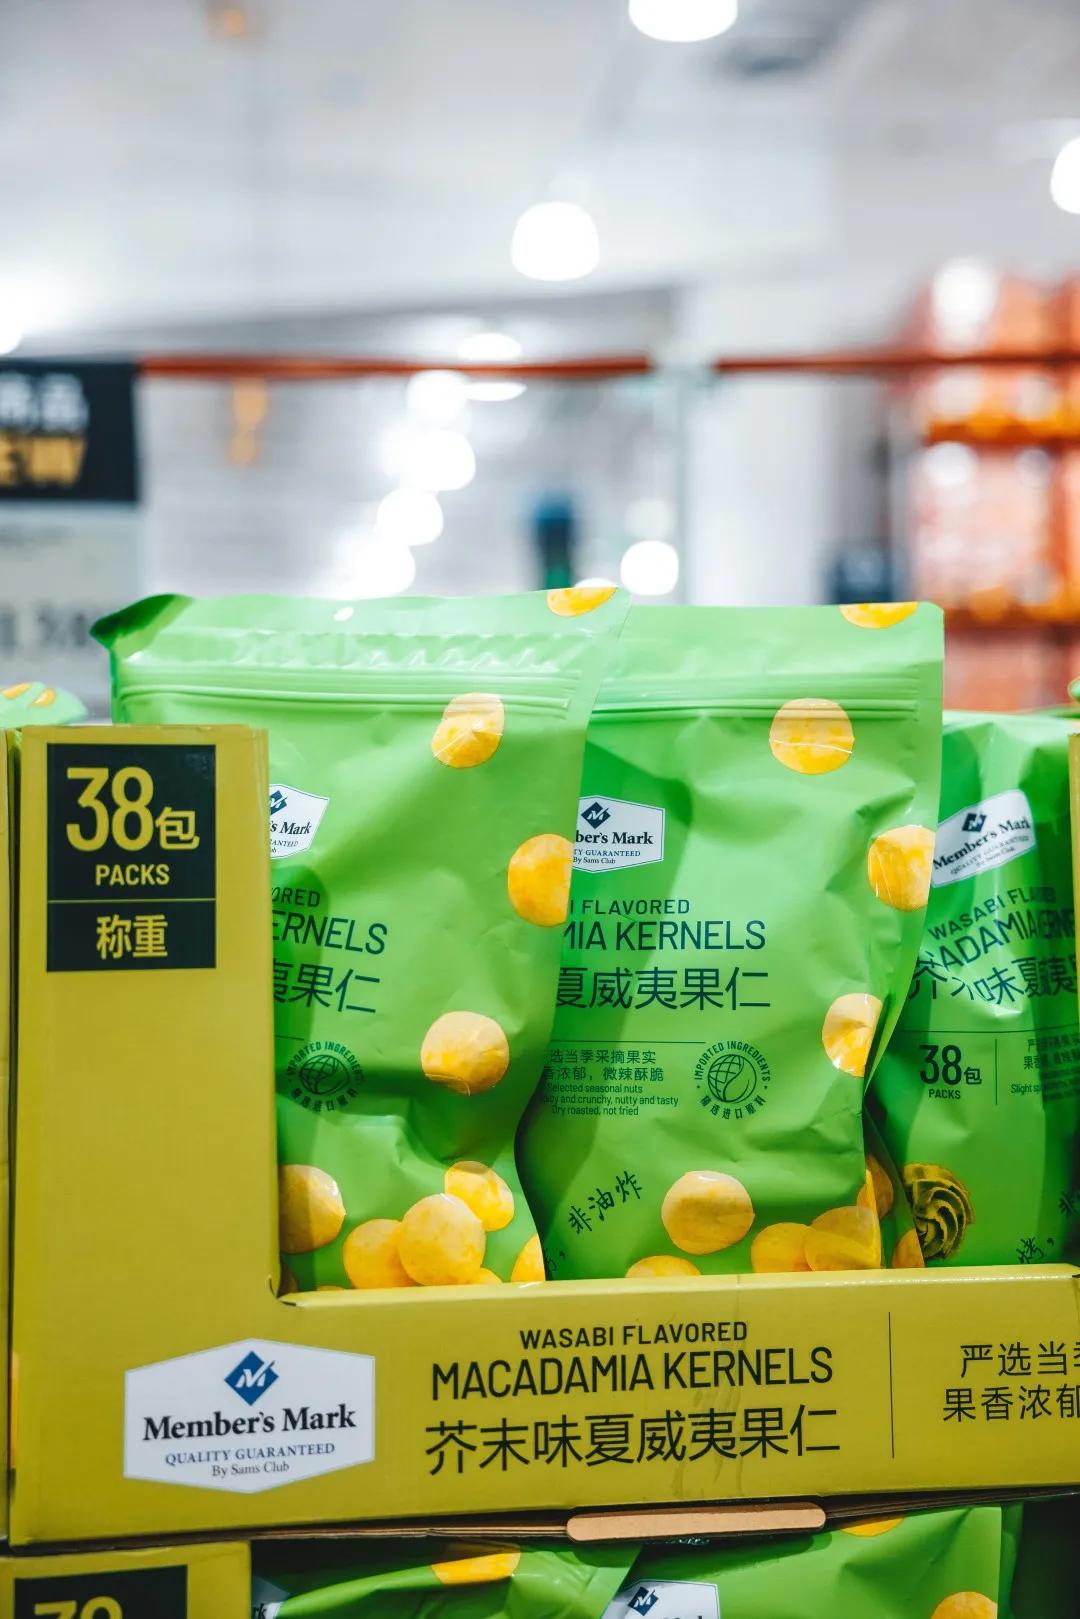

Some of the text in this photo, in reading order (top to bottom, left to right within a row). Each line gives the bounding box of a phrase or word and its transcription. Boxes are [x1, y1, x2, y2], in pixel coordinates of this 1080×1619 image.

[66, 766, 200, 852] 38包
[279, 821, 312, 835] Mark
[612, 831, 654, 845] Mark
[585, 849, 641, 857] GUARANTEED
[600, 857, 616, 866] Club
[932, 831, 997, 870] Member's
[95, 864, 171, 886] PACKS
[582, 899, 690, 915] FLAVORED
[927, 894, 1005, 940] WASABI
[97, 914, 169, 961] 称重
[615, 919, 767, 951] KERNELS
[556, 966, 771, 1011] 夏威夷果仁
[695, 1040, 771, 1082] IMPORTED INGREDIENTS
[919, 1044, 983, 1086] 38包
[560, 1095, 576, 1104] and
[615, 1096, 637, 1106] nutty
[639, 1096, 655, 1105] and
[657, 1096, 679, 1107] tasty
[585, 1084, 622, 1093] seasonal
[624, 1084, 643, 1093] nuts
[928, 1088, 961, 1100] PACKS
[603, 1107, 617, 1115] not
[567, 1170, 643, 1234] 非油炸
[519, 1321, 749, 1350] WASABI FLAVORED
[431, 1346, 833, 1401] MACADAMIA KERNELS
[960, 1340, 1080, 1378] 严选当
[943, 1383, 1080, 1423] 果香浓郁
[142, 1403, 357, 1441] Member's Mark
[164, 1442, 336, 1467] QUALITY GUARANTEED
[424, 1403, 841, 1477] 芥末味夏威夷果仁
[211, 1464, 228, 1478] By
[263, 1460, 290, 1474] Club
